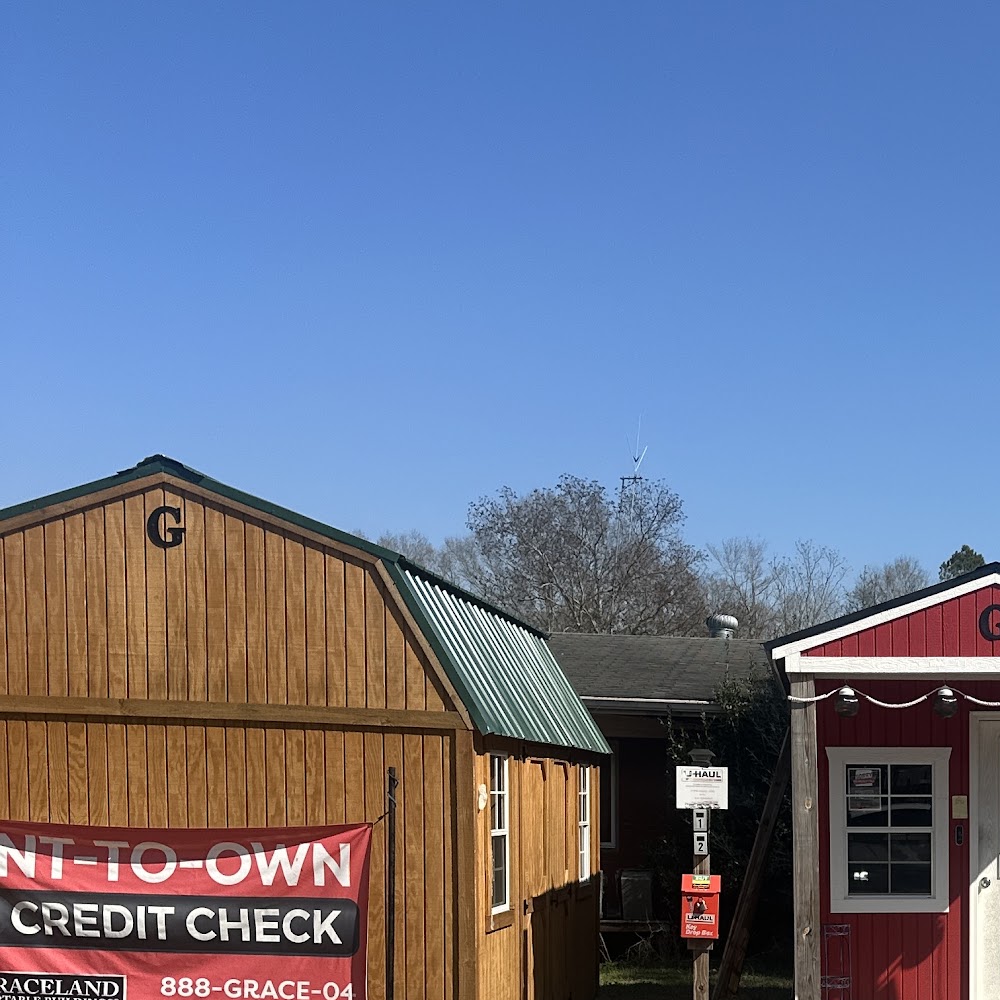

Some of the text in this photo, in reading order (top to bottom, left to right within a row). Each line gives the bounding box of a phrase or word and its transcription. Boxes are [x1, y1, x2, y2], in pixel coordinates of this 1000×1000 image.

[147, 506, 186, 549] G
[698, 818, 702, 829] 1
[698, 842, 704, 852] 2
[10, 901, 343, 945] CREDIT CHECK
[685, 923, 698, 931] Key
[685, 929, 713, 937] Drop Box
